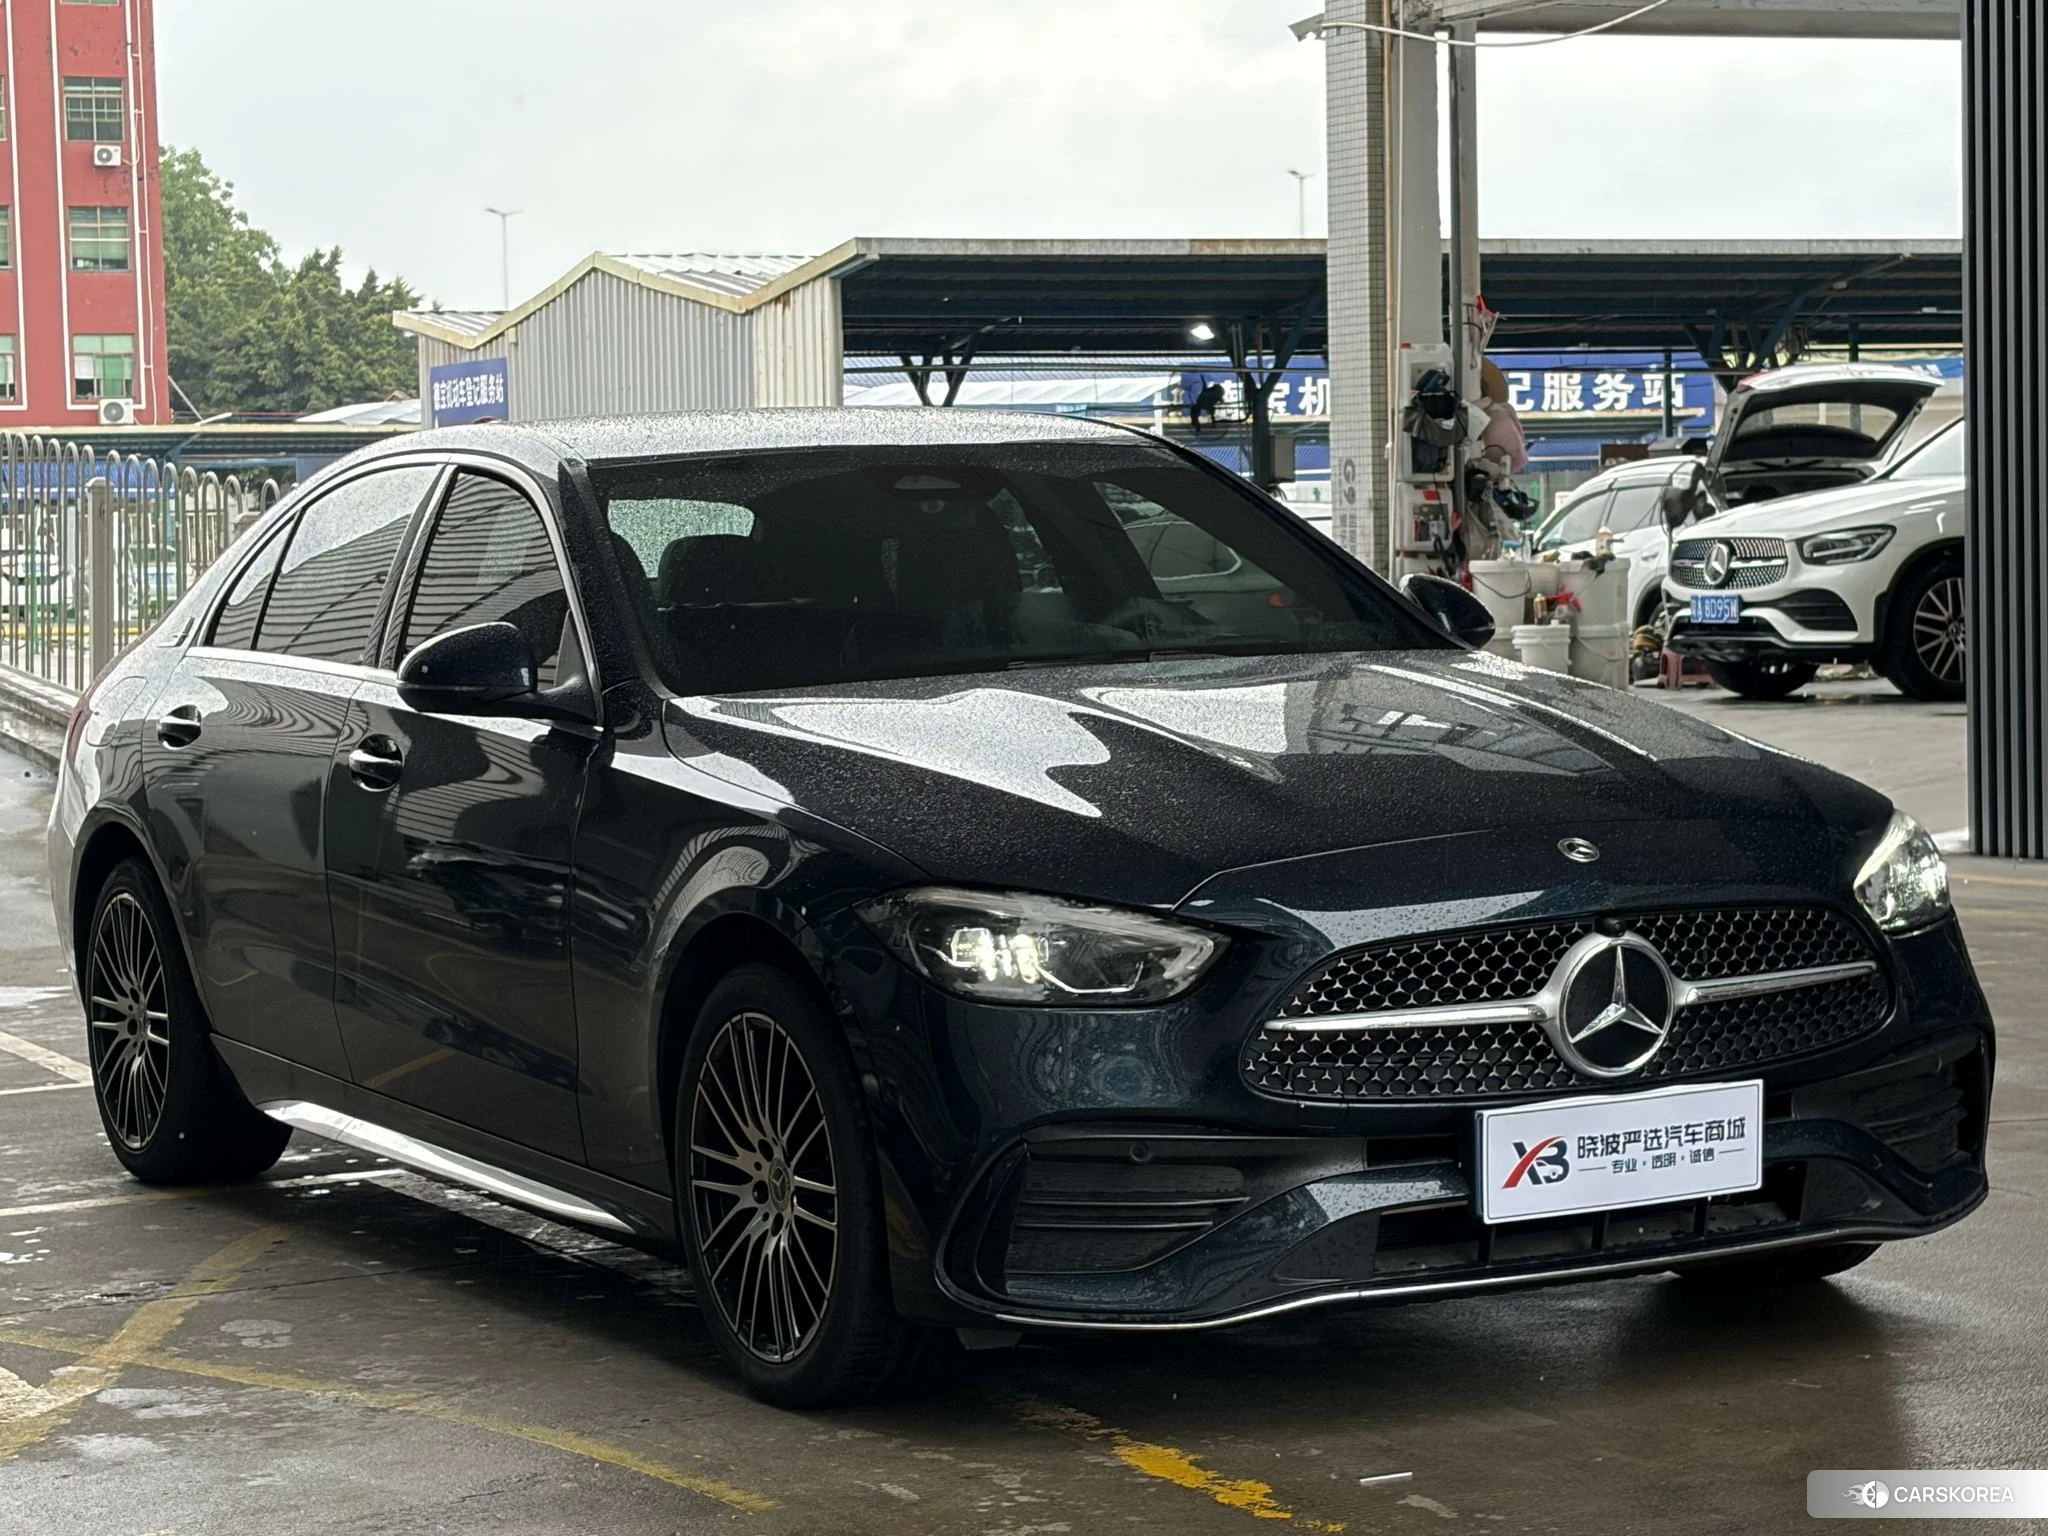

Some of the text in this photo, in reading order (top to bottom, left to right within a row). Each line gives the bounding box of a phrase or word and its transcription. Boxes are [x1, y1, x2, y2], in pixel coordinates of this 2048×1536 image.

[1577, 1115, 1746, 1160] 晓波严选汽车商城
